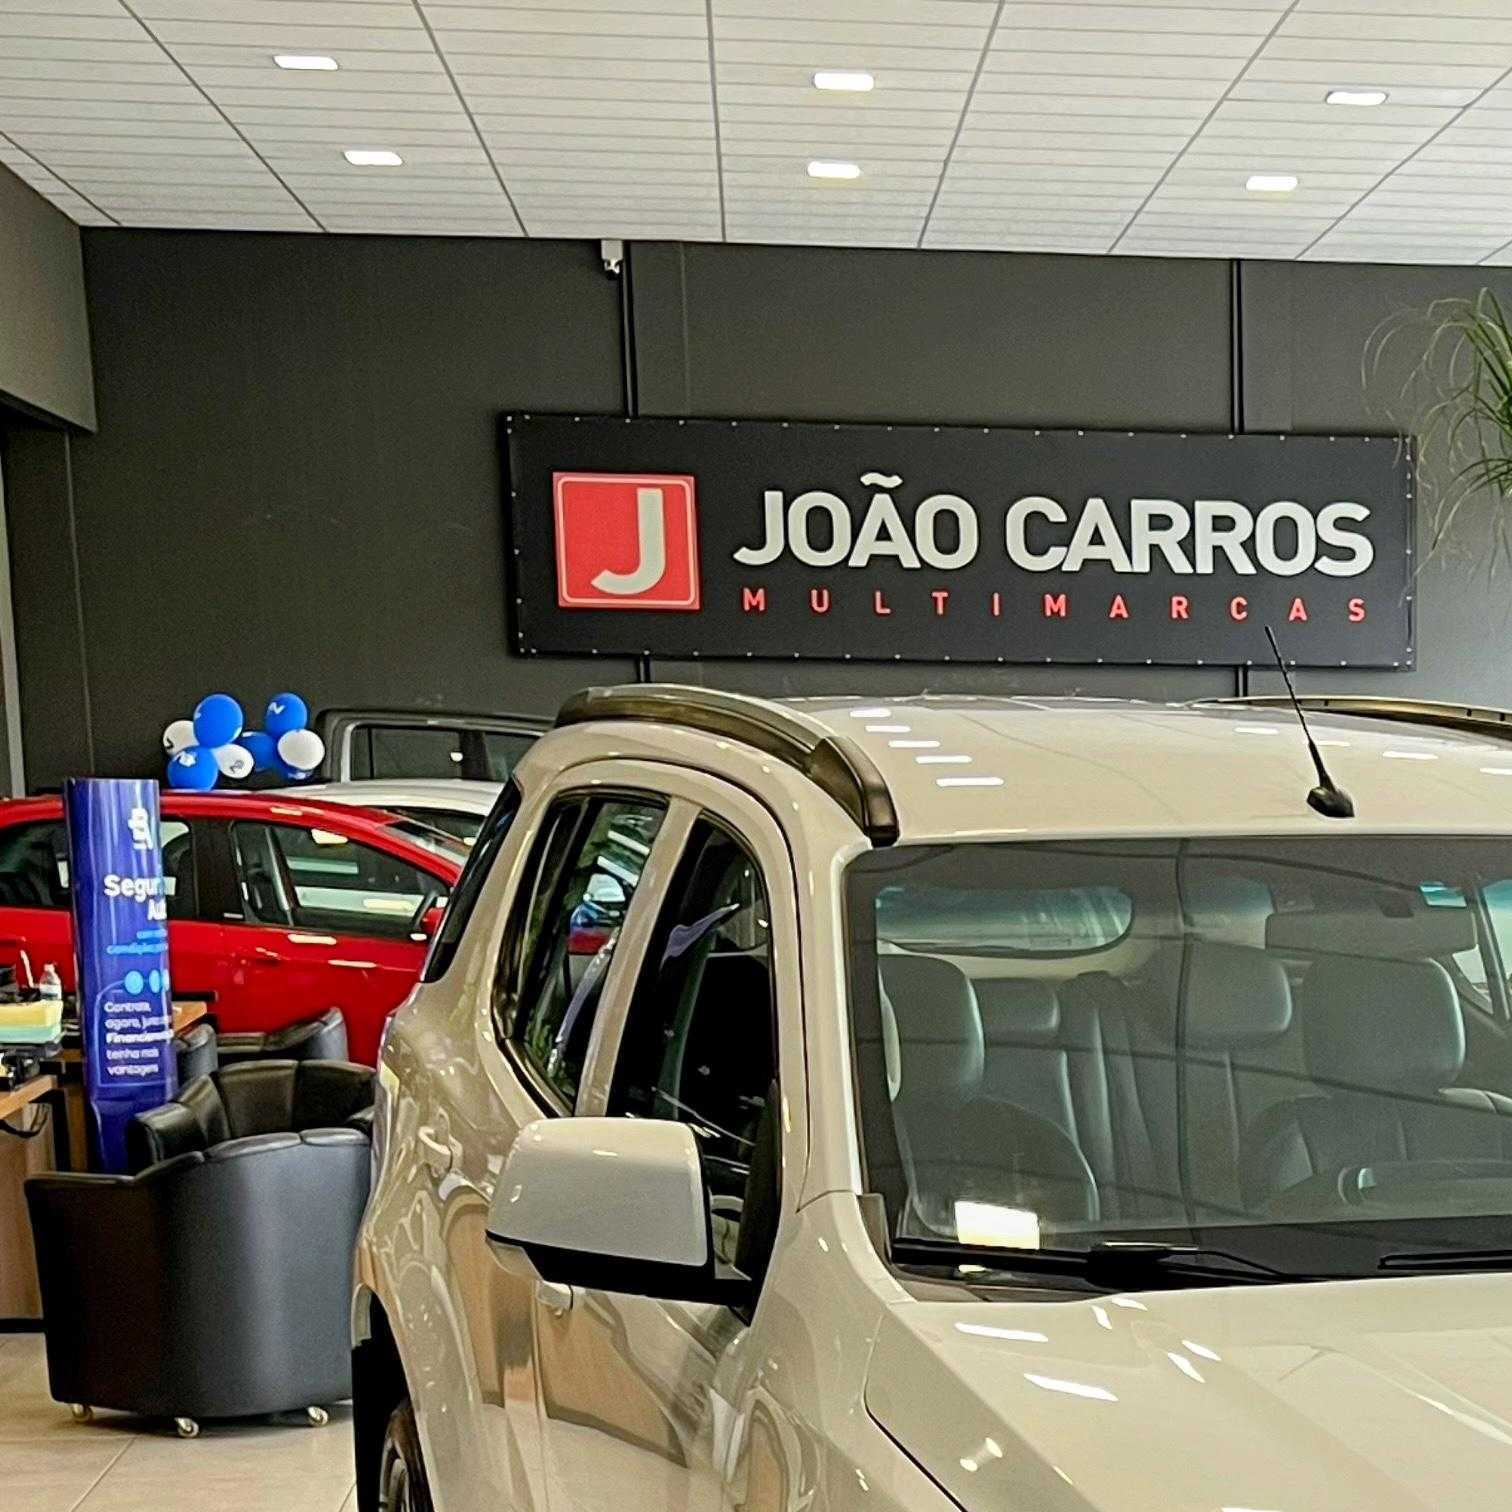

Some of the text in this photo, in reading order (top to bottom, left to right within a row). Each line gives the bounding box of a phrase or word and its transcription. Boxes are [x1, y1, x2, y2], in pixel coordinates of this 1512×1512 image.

[590, 486, 667, 595] J
[732, 471, 1375, 577] JOÃO CARROS
[742, 587, 1366, 623] MULTIMARCAS
